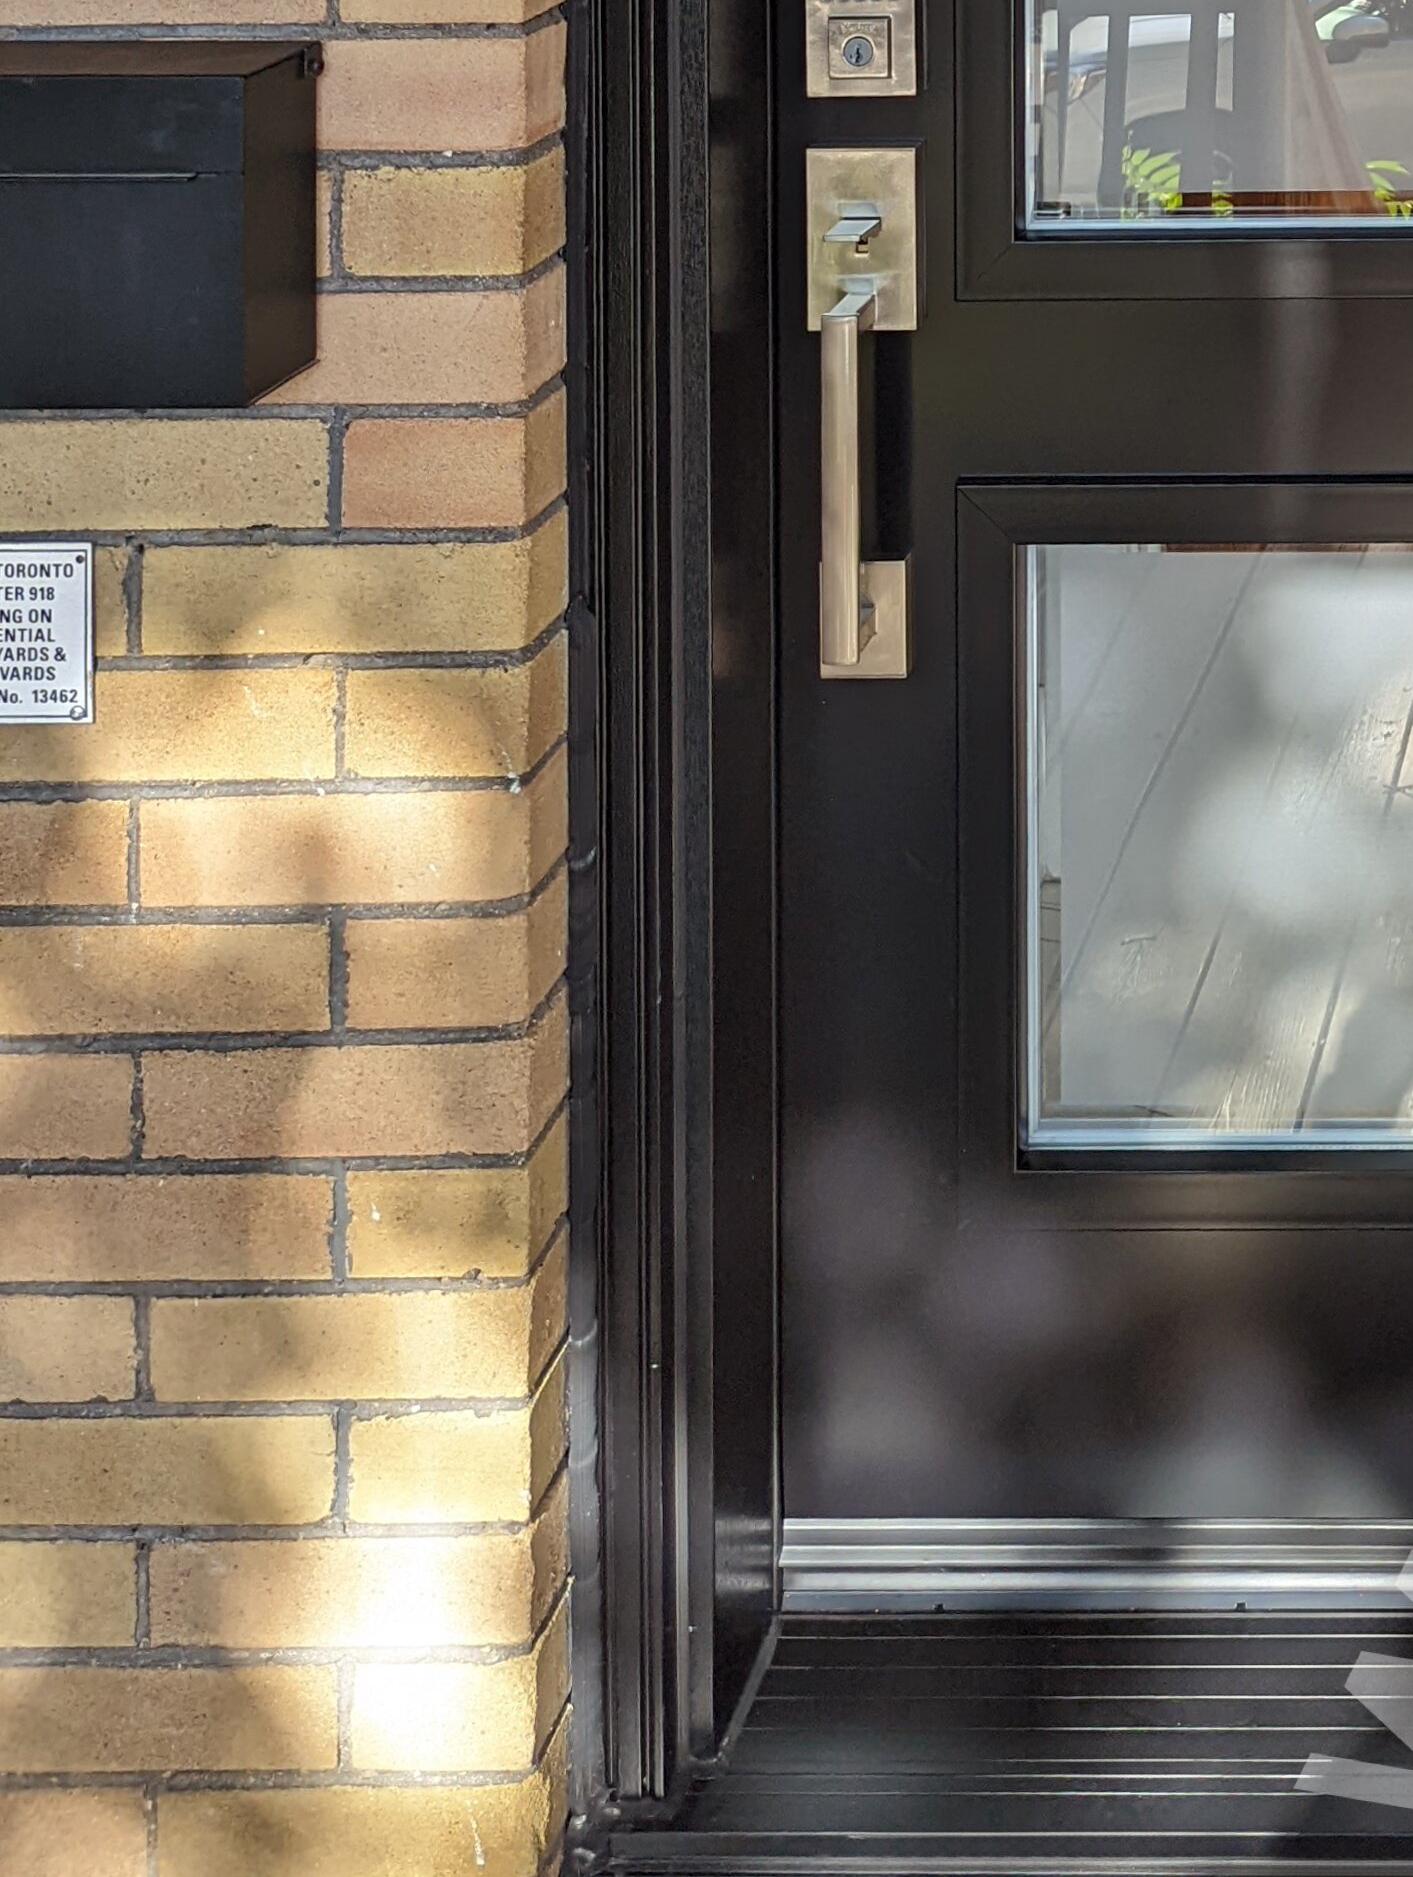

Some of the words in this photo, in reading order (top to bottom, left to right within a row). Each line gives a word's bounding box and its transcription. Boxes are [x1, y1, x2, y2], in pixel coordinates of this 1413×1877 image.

[28, 586, 55, 601] 918
[28, 608, 53, 624] ON
[0, 646, 50, 662] ARDS
[53, 646, 68, 662] &
[0, 688, 23, 704] No.
[31, 688, 79, 704] 13462
